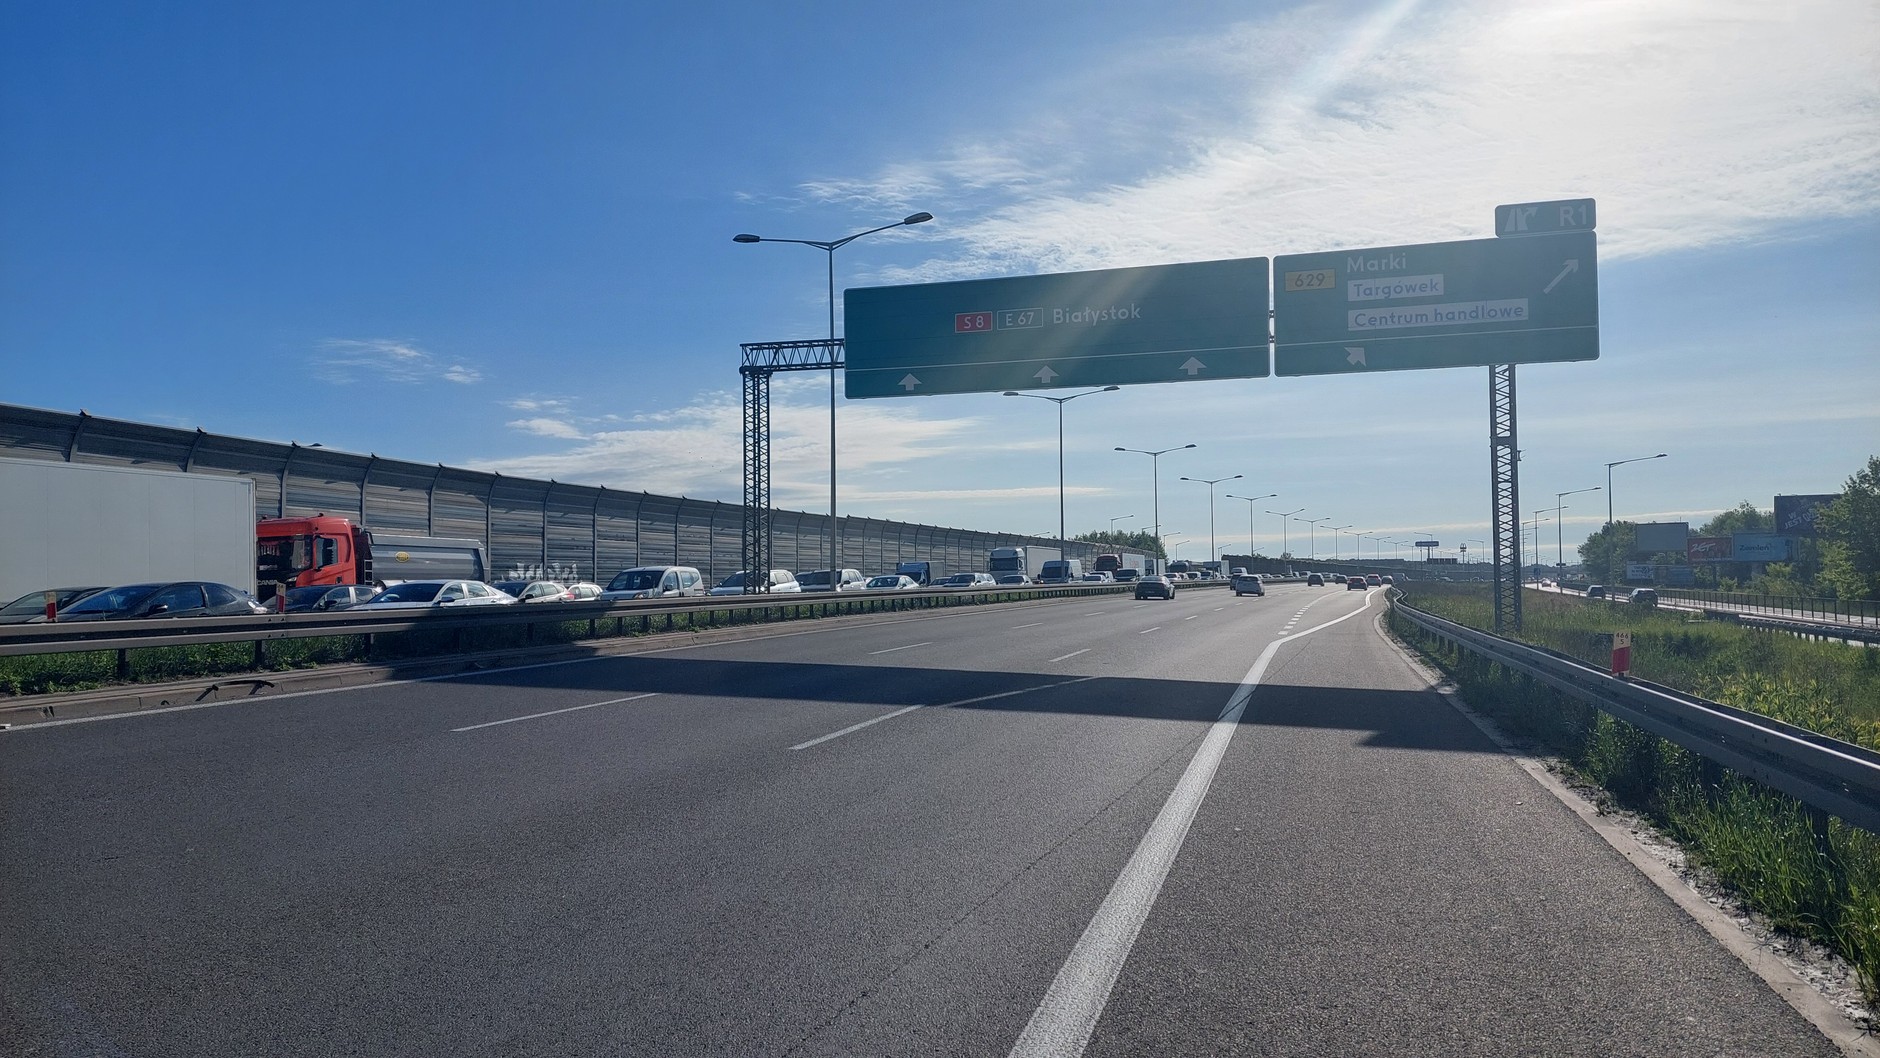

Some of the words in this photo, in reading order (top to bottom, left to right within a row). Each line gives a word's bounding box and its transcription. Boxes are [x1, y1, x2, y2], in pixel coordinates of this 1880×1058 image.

[1558, 204, 1589, 227] R1
[1346, 252, 1407, 273] Marki
[1294, 272, 1326, 288] 629
[1353, 279, 1440, 299] Targówek
[1017, 311, 1035, 326] 67
[1052, 303, 1142, 327] Białystok
[1354, 309, 1429, 328] Centrum
[1433, 305, 1524, 323] handlowe
